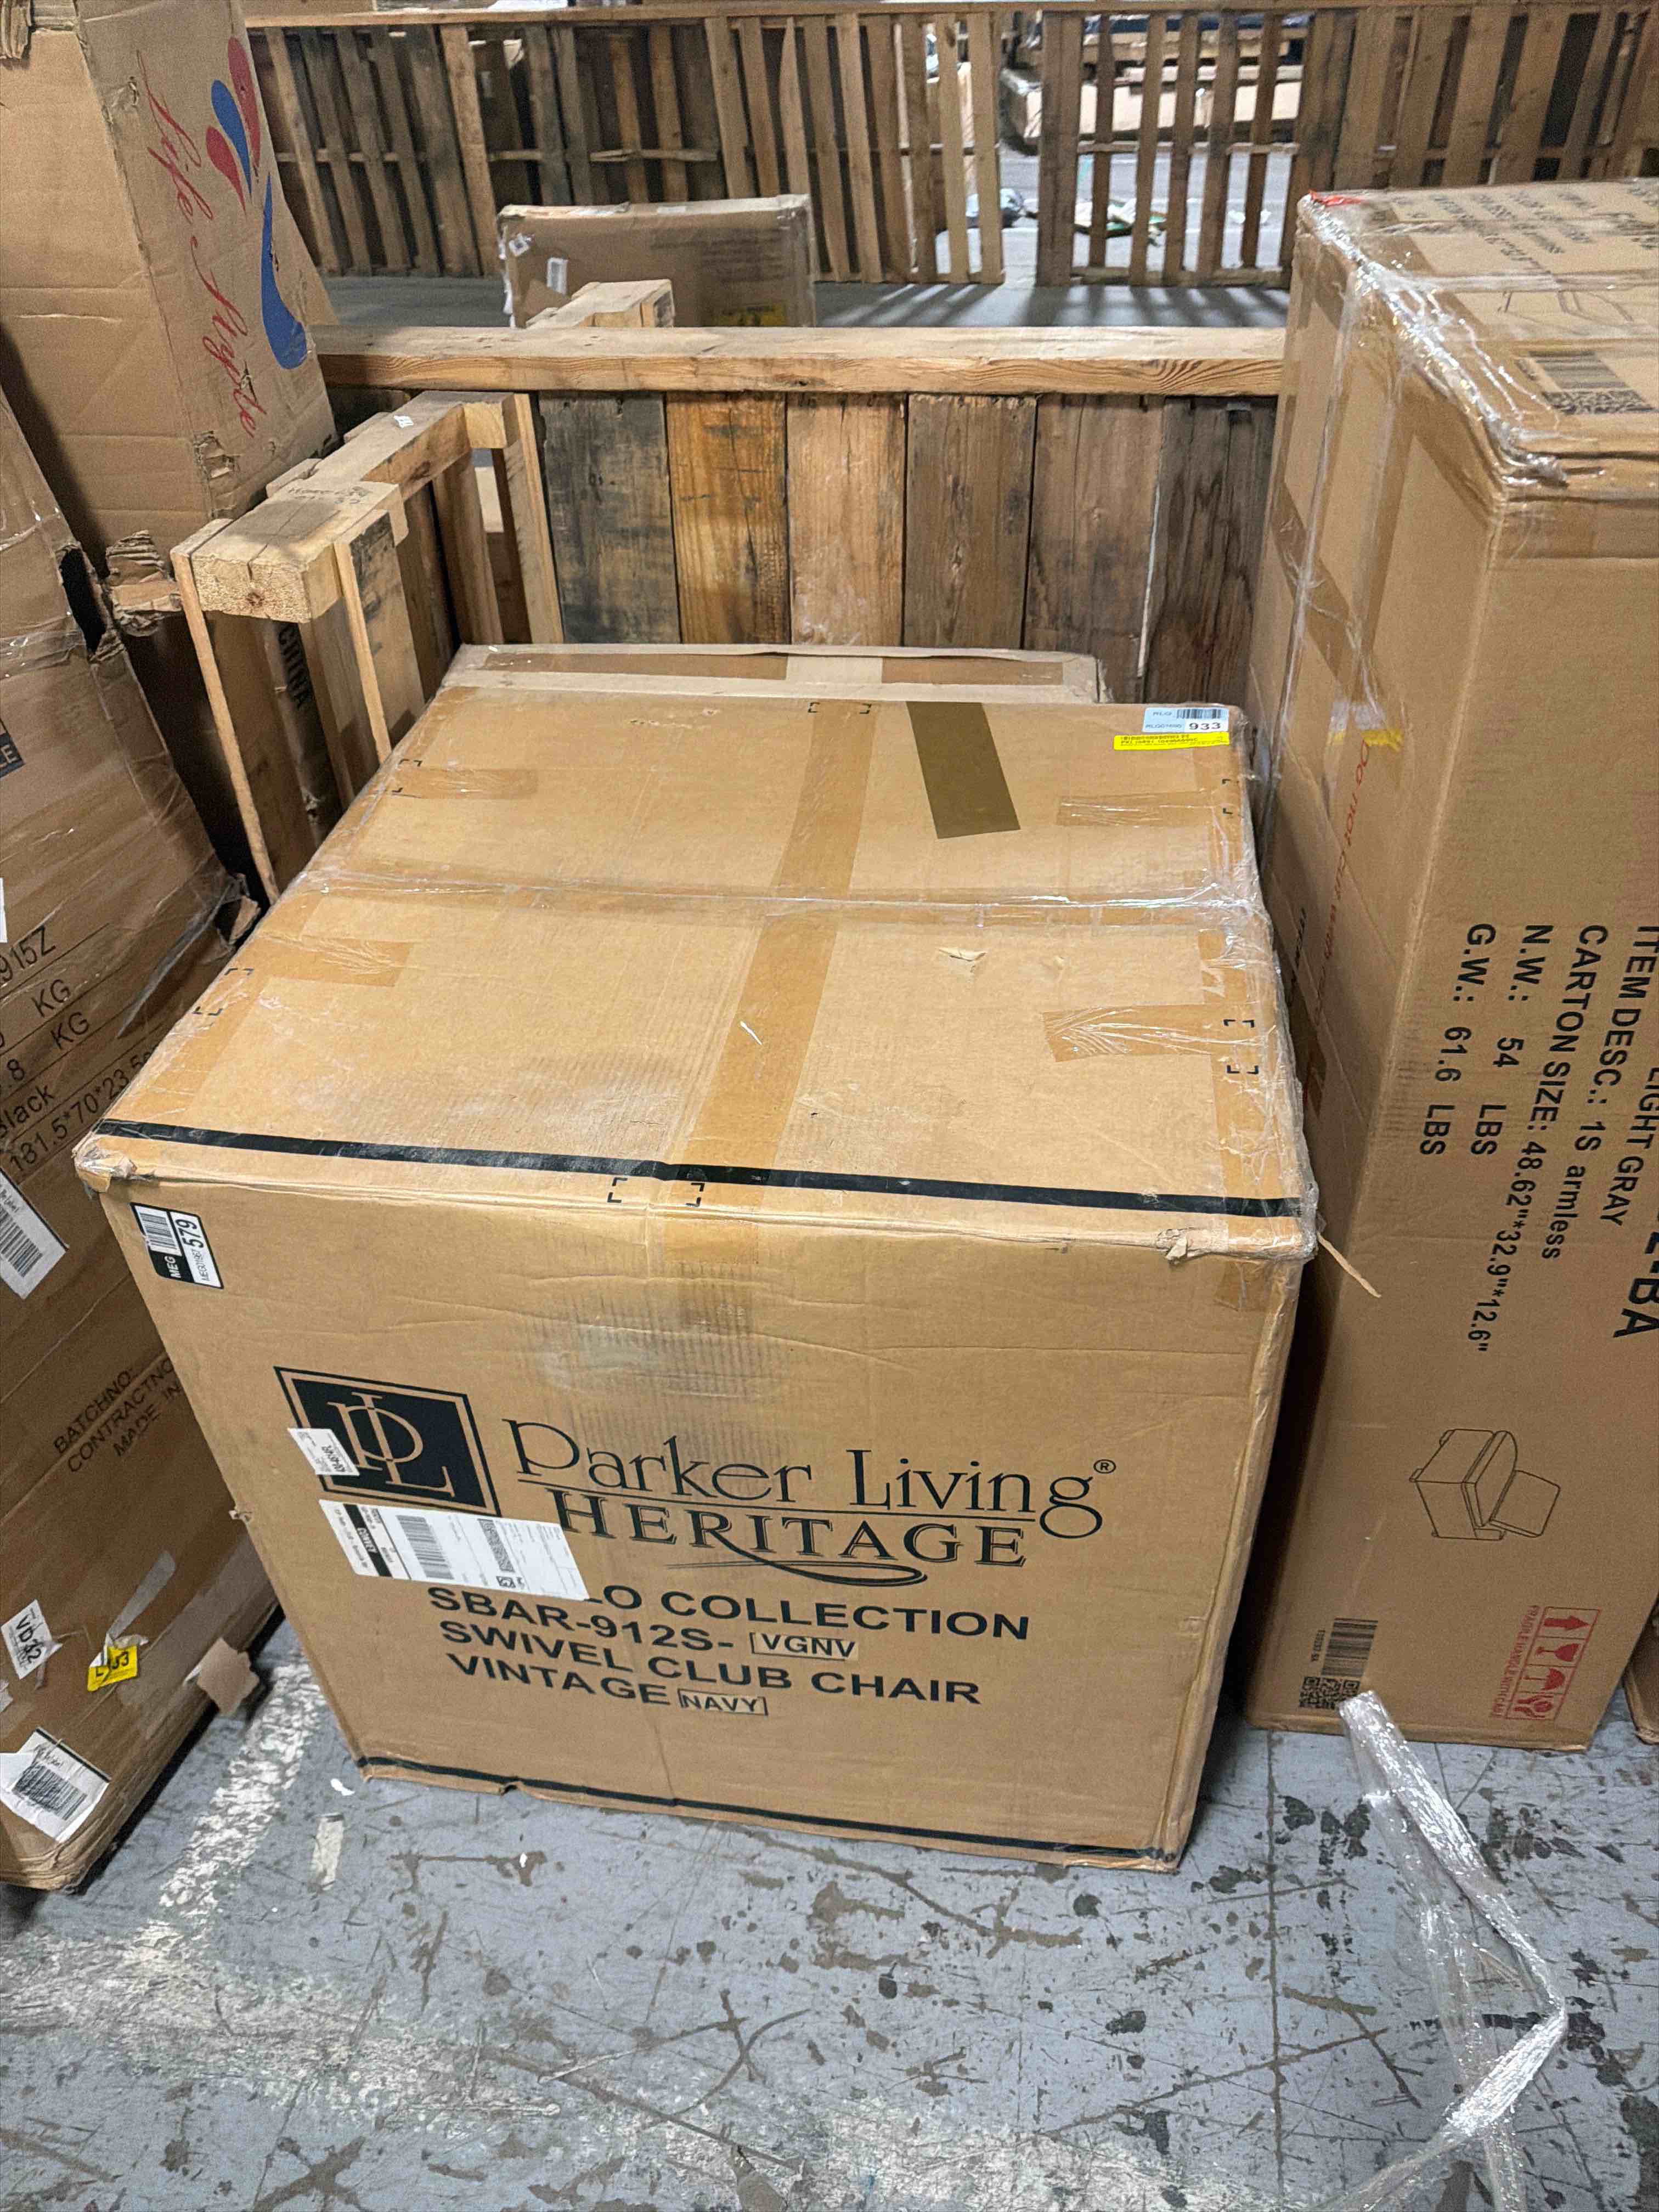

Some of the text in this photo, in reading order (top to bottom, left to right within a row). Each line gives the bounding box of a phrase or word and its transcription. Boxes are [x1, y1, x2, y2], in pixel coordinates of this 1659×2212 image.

[1189, 722, 1221, 731] 933
[1550, 925, 1608, 1052] CARTON
[1618, 926, 1659, 998] ITEM
[31, 979, 71, 1018] KG
[50, 1012, 89, 1049] KG
[1435, 1026, 1471, 1082] 61.6
[1493, 1036, 1524, 1068] 54
[1528, 1061, 1571, 1131] SIZE:
[1420, 1104, 1455, 1156] LBS
[1471, 1104, 1506, 1156] LBS
[1541, 1165, 1586, 1260] armless
[1599, 1155, 1644, 1226] GRAY
[175, 1219, 204, 1248] 579
[165, 1256, 182, 1278] MEG
[113, 1404, 163, 1457] MADE
[501, 1419, 812, 1503] Parker
[545, 1488, 1027, 1587] HERITAGE
[661, 1587, 1030, 1640] COLLECTION
[439, 1620, 982, 1705] SWIVEL CLUB CHAIR
[761, 1633, 856, 1658] VGNV
[445, 1653, 761, 1713] VINTAGE NAVY
